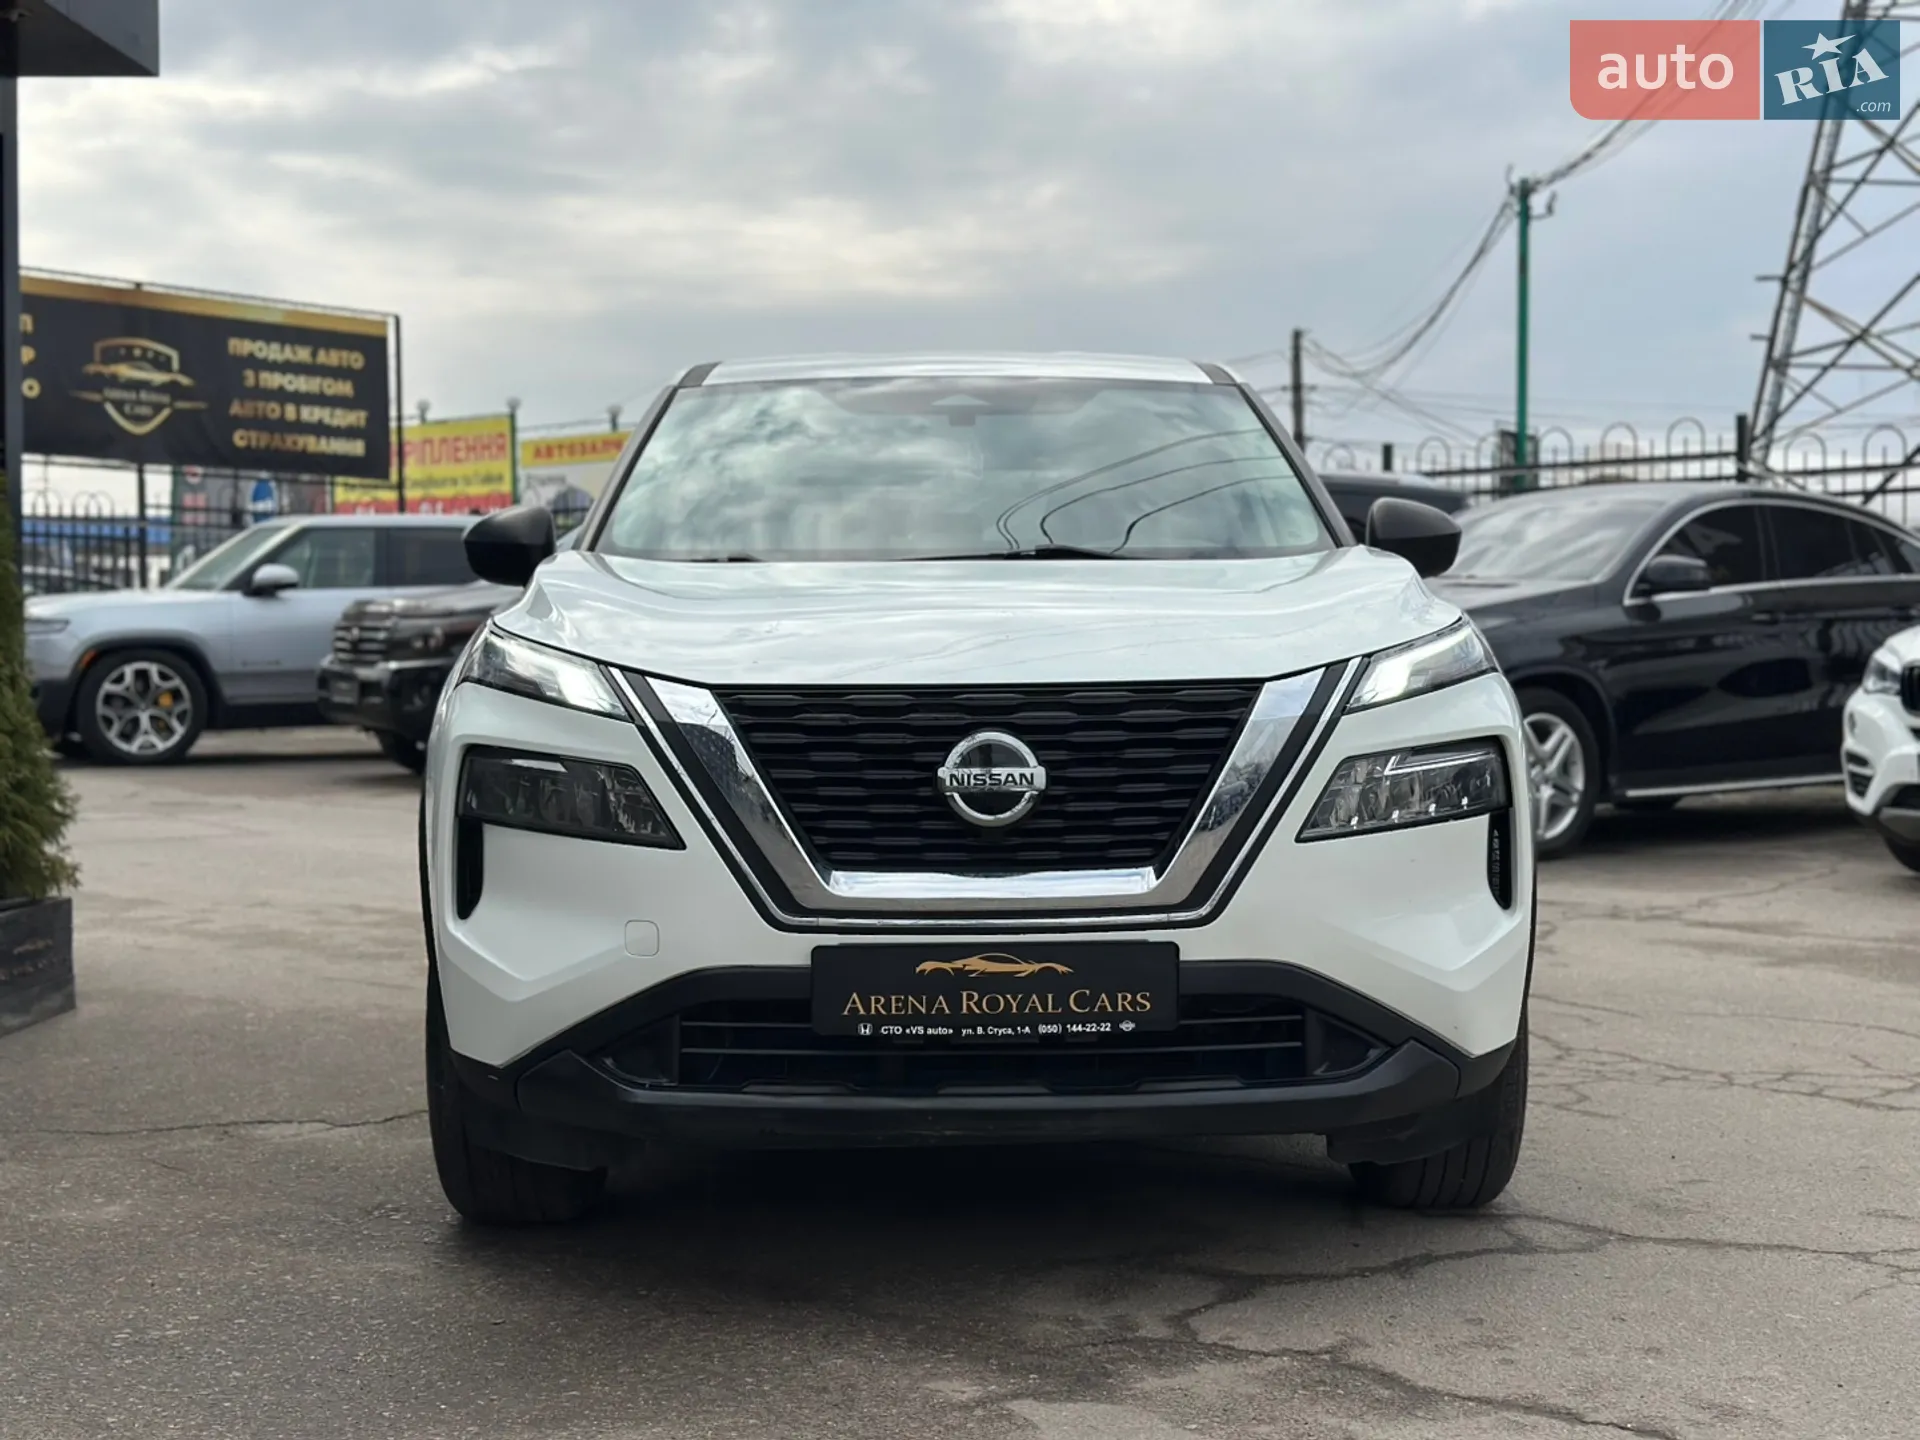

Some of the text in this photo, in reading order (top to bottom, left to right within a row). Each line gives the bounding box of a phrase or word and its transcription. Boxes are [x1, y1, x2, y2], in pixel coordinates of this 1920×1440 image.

[228, 337, 365, 370] ПРОДАЖ АВТО
[259, 370, 354, 399] ПРОБІГОМ
[229, 399, 367, 428] АВТО В КРЕДИТ
[232, 428, 365, 457] СТРАХУВАННЯ
[390, 432, 507, 468] РІПЛЕННЯ
[949, 773, 1034, 786] NISSAN
[842, 989, 1151, 1015] ARENA ROYAL CARS
[880, 1025, 903, 1035] СТО
